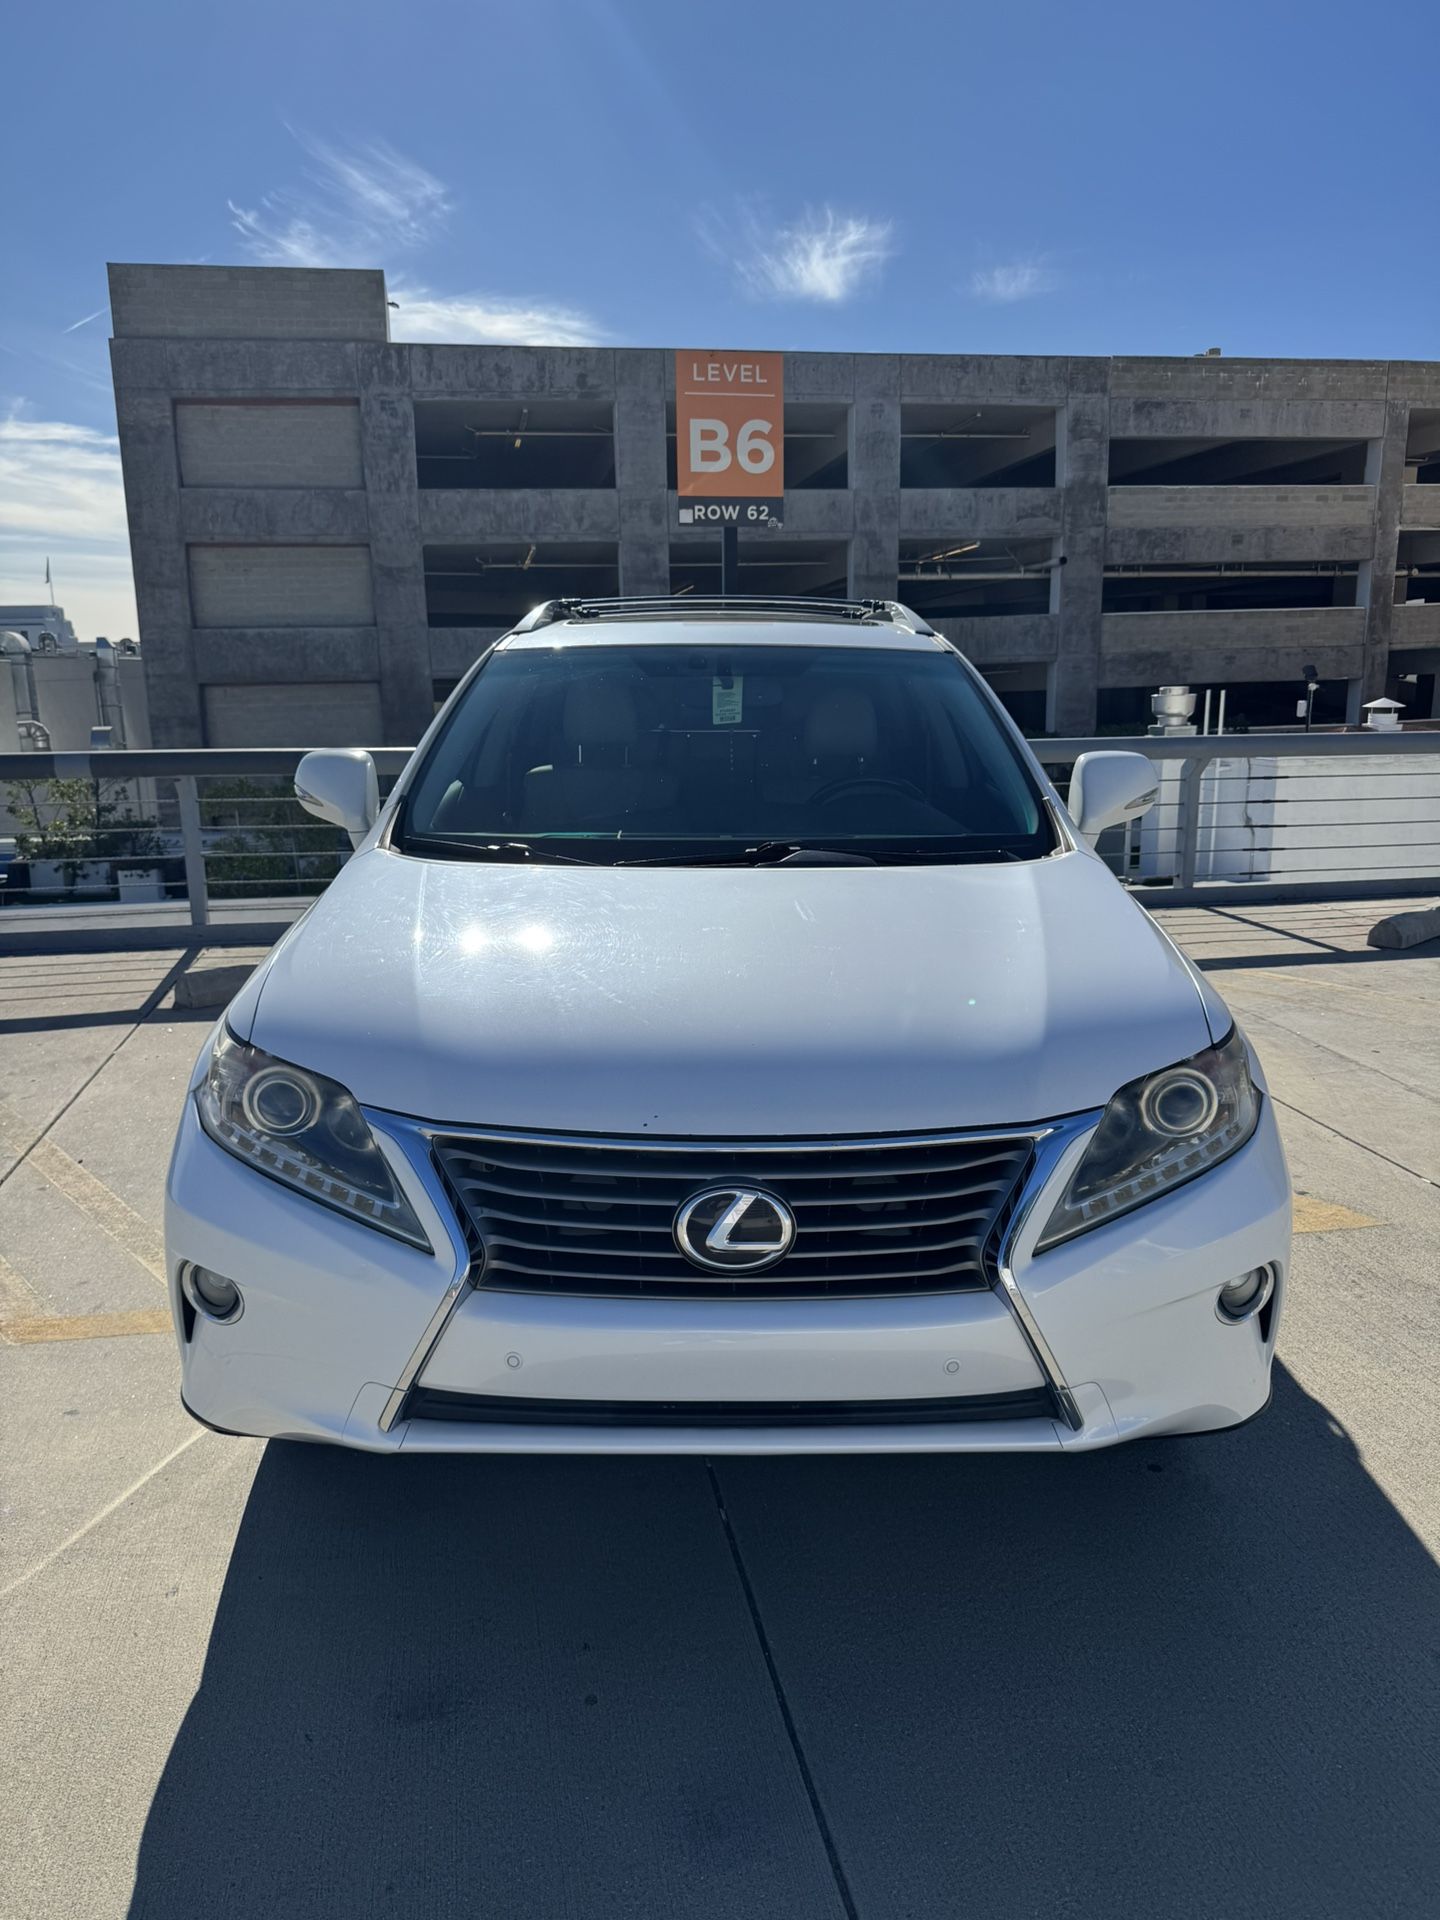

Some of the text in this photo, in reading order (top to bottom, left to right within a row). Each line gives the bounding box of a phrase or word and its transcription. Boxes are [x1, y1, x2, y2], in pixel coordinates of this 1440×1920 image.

[693, 363, 768, 383] LEVEL
[689, 418, 776, 475] B6
[694, 505, 769, 520] ROW 62
